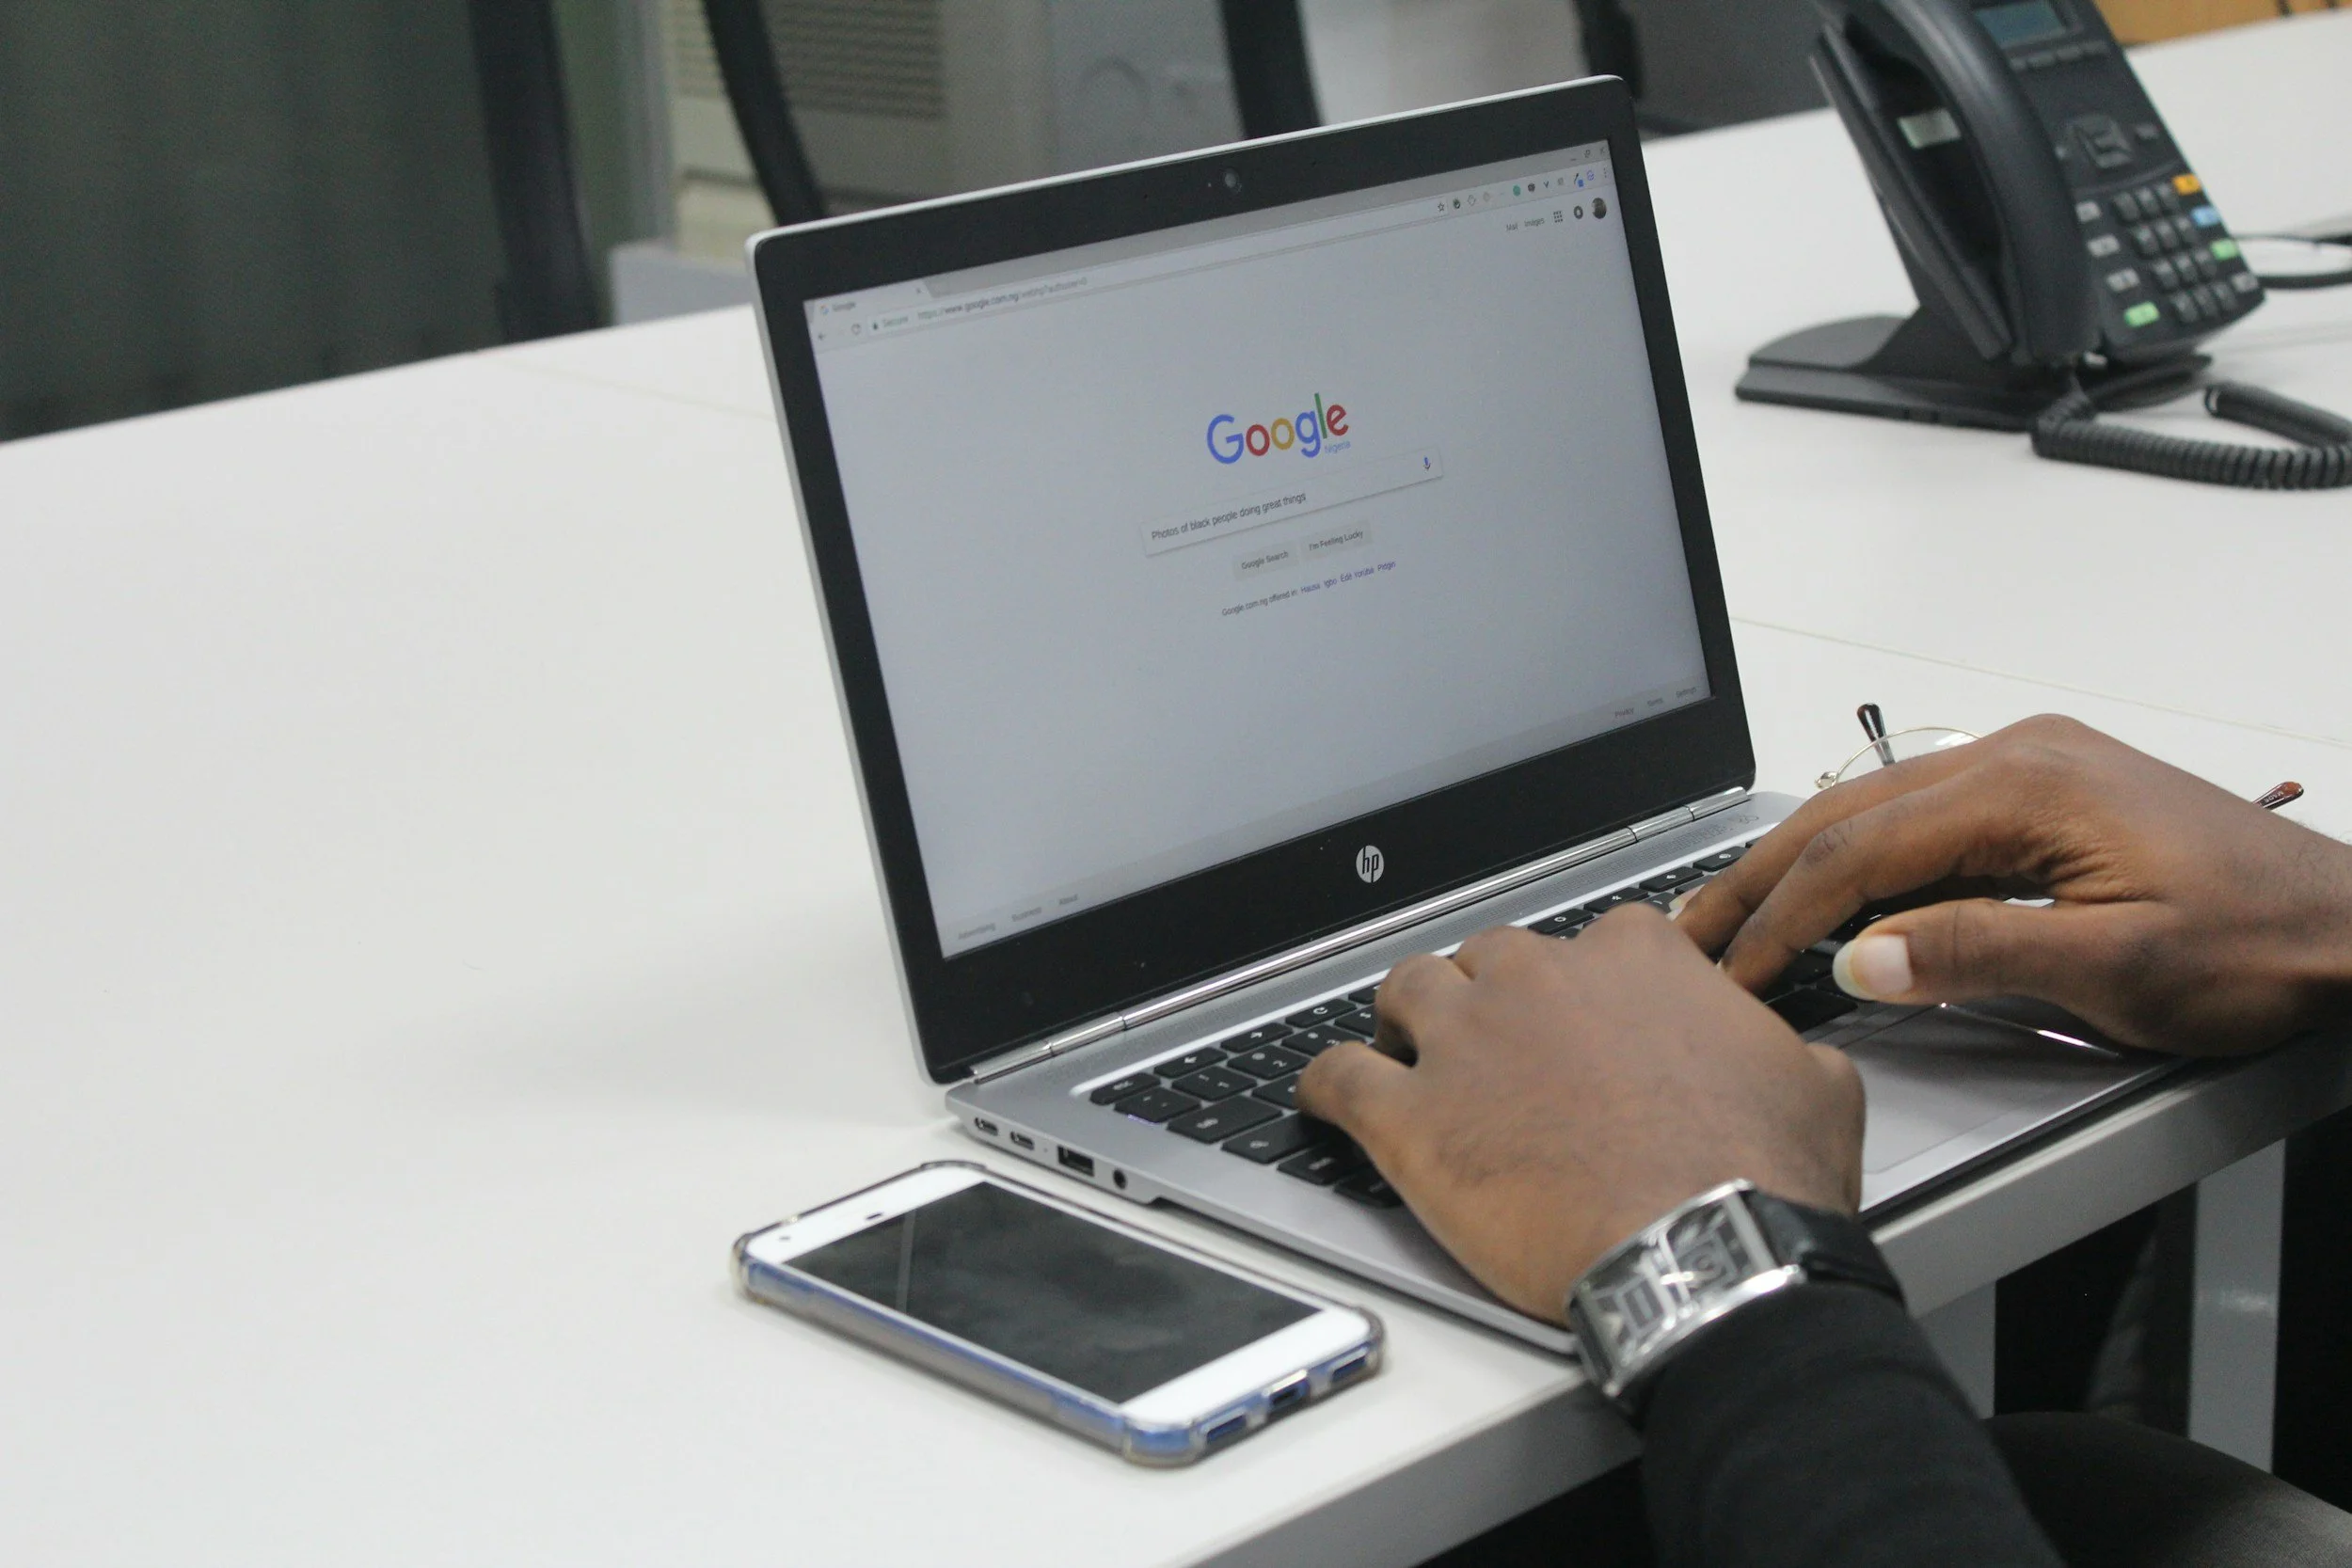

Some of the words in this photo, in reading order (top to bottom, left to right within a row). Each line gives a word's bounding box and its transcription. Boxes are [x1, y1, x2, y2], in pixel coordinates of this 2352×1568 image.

[1523, 216, 1546, 228] Images
[1206, 391, 1349, 465] Google
[1324, 440, 1351, 453] Nigeria
[1151, 527, 1180, 540] Photos
[1181, 522, 1188, 533] of
[1189, 518, 1211, 532] black
[1212, 511, 1238, 527] people
[1239, 504, 1262, 517] doing
[1262, 499, 1282, 514] great
[1282, 492, 1307, 506] things
[1320, 535, 1343, 547] Feeling
[1343, 530, 1364, 543] Lucky
[1241, 557, 1265, 570] Google
[1266, 549, 1289, 563] Search
[1268, 591, 1291, 604] offered
[1300, 581, 1321, 594] Hausa
[1324, 578, 1338, 589] Igbo
[1360, 845, 1381, 883] hp
